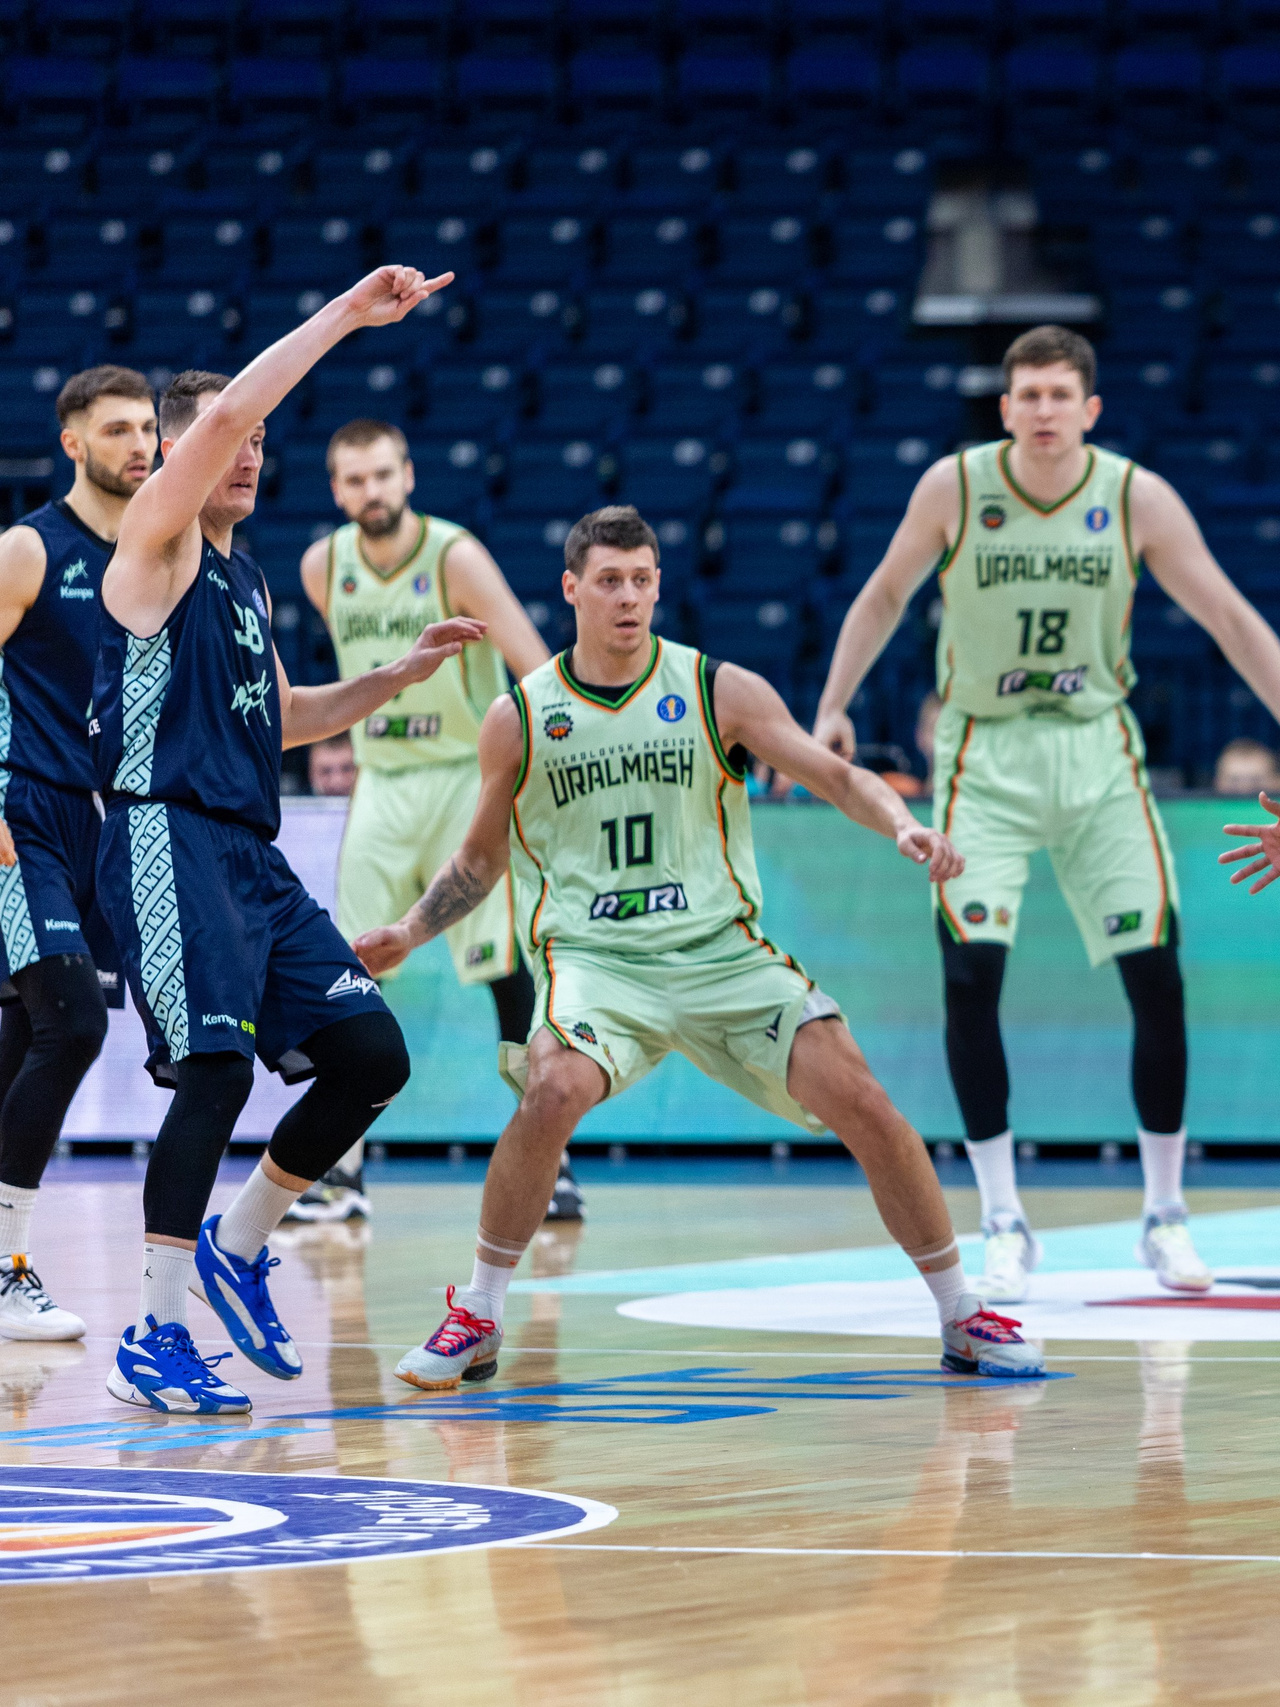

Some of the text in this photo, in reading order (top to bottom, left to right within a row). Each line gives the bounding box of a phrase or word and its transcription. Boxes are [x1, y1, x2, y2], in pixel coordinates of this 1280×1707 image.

[976, 552, 1113, 588] URALMASH
[1017, 609, 1070, 656] 18
[544, 737, 695, 769] SVERDLOVSK REGION
[547, 748, 695, 809] URALMASH
[601, 812, 654, 871] 10
[292, 1489, 492, 1532] LEAGUE
